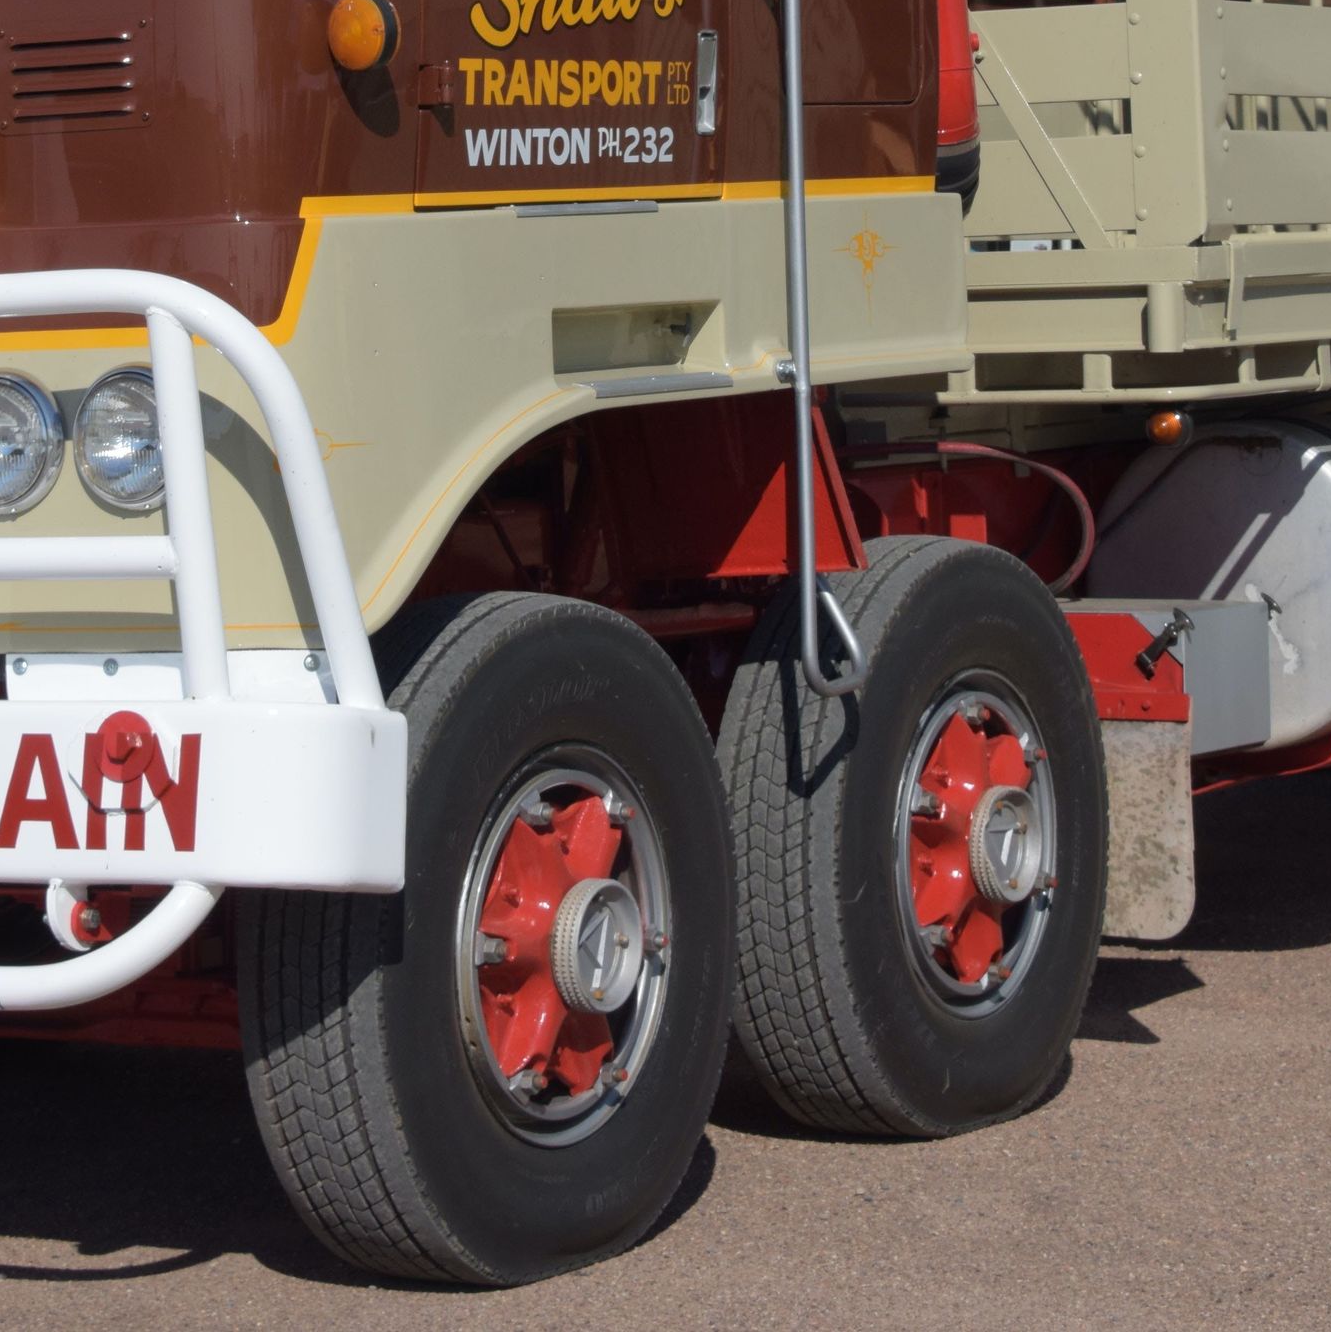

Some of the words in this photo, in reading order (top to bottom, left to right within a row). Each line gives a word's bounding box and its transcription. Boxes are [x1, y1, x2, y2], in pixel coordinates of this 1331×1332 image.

[459, 58, 662, 107] TRANSPORT
[667, 61, 691, 81] PTY
[667, 84, 690, 105] LTD
[465, 127, 590, 166] WINTON
